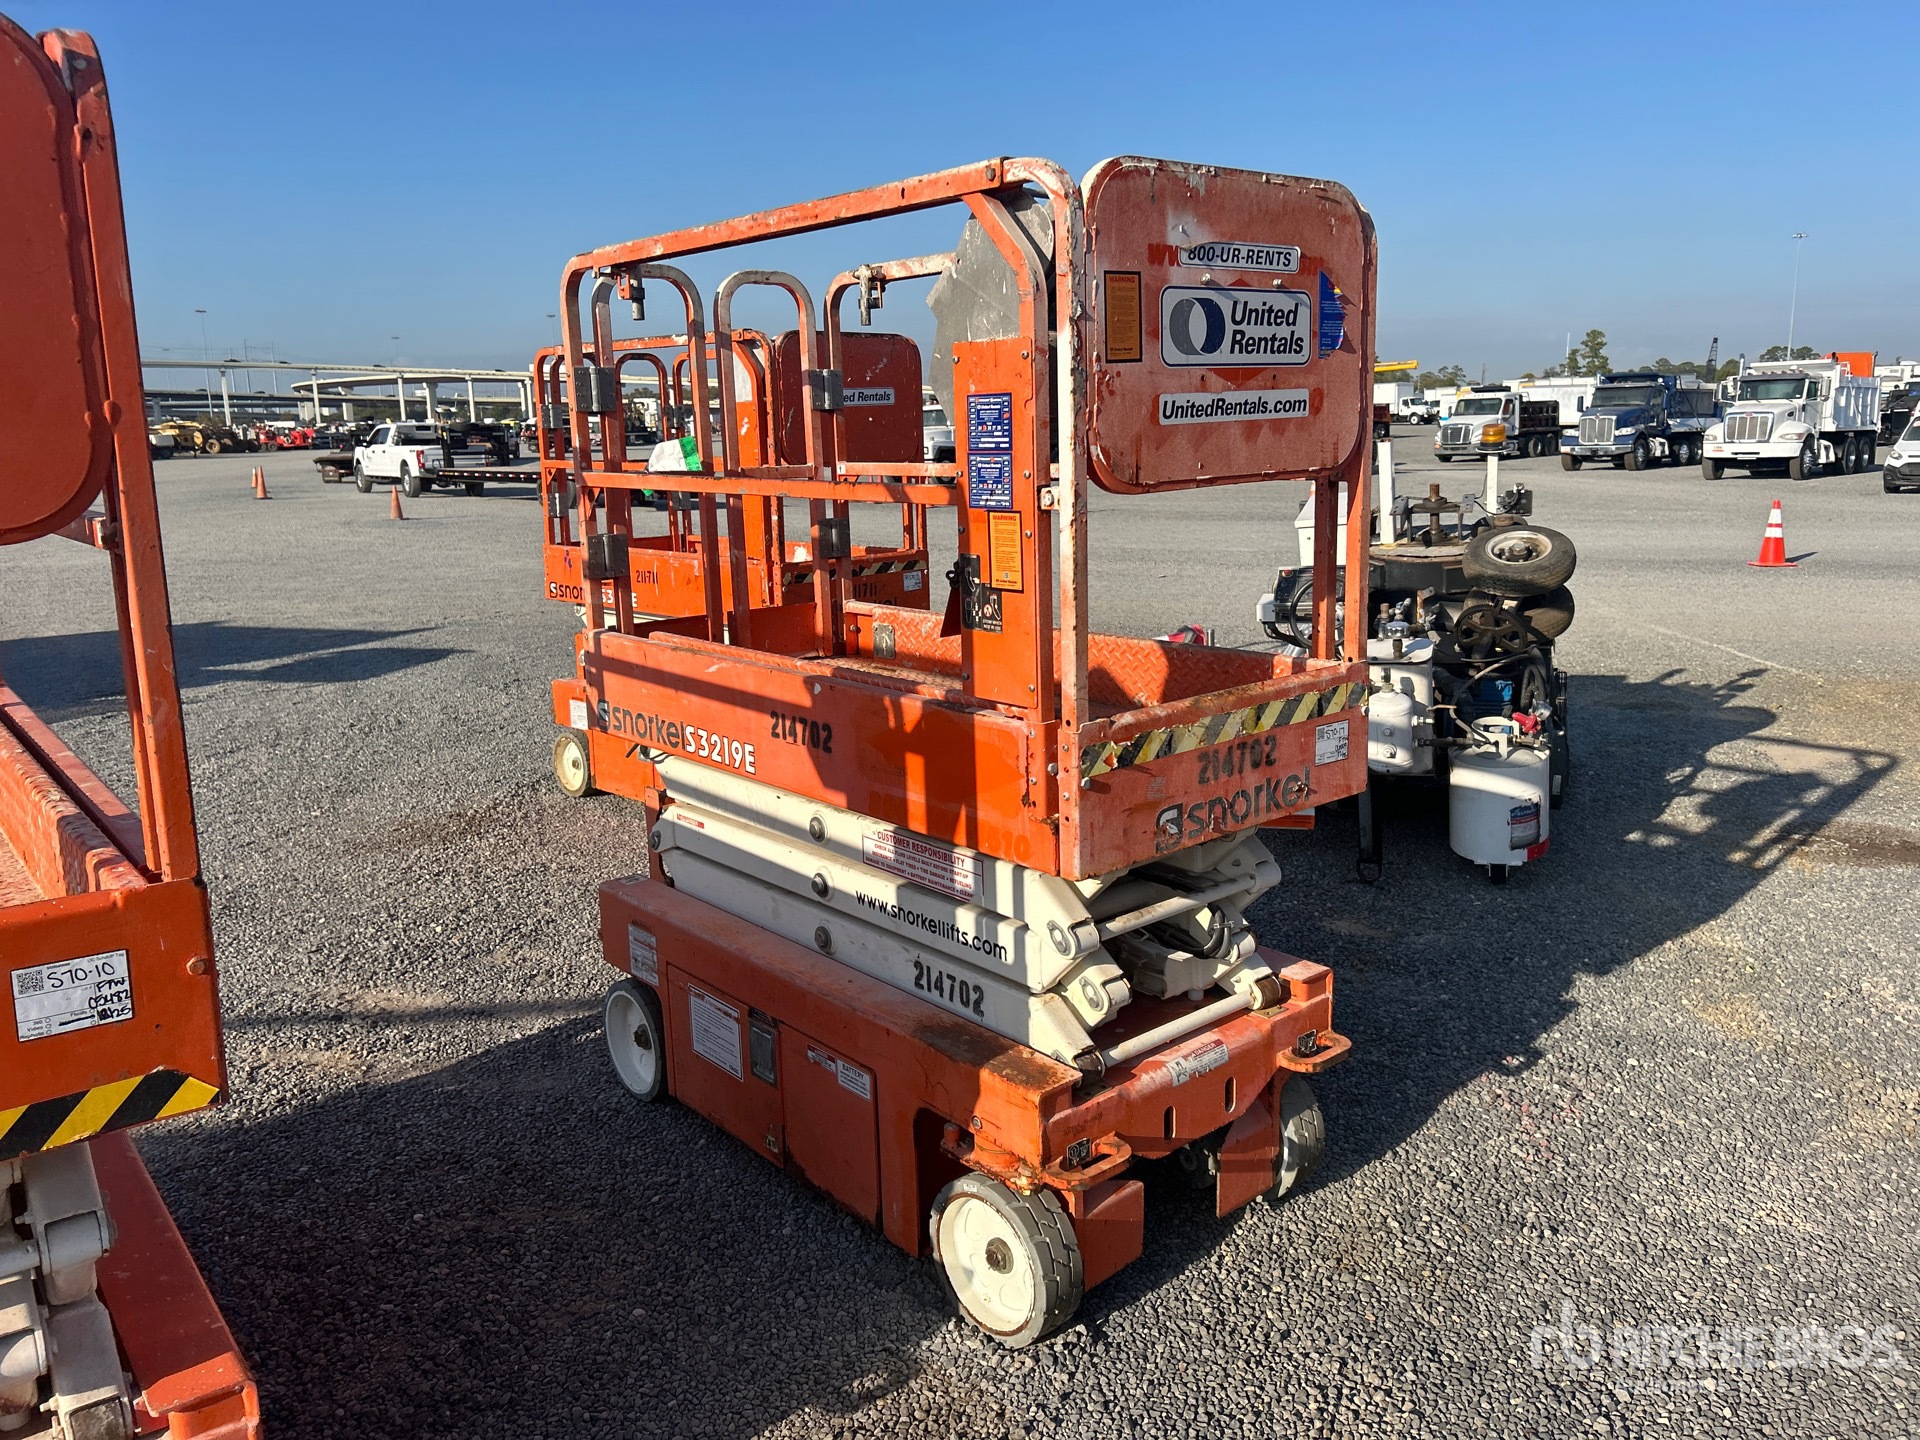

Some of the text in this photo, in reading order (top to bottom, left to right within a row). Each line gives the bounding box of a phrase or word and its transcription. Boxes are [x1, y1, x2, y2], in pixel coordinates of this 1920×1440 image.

[1230, 300, 1298, 327] United
[1229, 329, 1304, 357] Rentals
[857, 391, 891, 402] Rentals
[1161, 396, 1308, 421] UnitedRentals.com
[612, 704, 686, 751] snorkel
[685, 725, 756, 775] S3219E
[769, 710, 833, 754] 214702
[1197, 735, 1278, 785] 214702
[1186, 765, 1312, 838] snorkel
[877, 831, 911, 850] CUSTOMER
[911, 842, 965, 867] RESPONSIBILITY
[855, 890, 1008, 962] www.snorkellifts.com
[47, 961, 115, 988] S70-10
[913, 960, 985, 1018] 214702
[1194, 1043, 1217, 1056] DANGER
[842, 1063, 864, 1080] BATTERY
